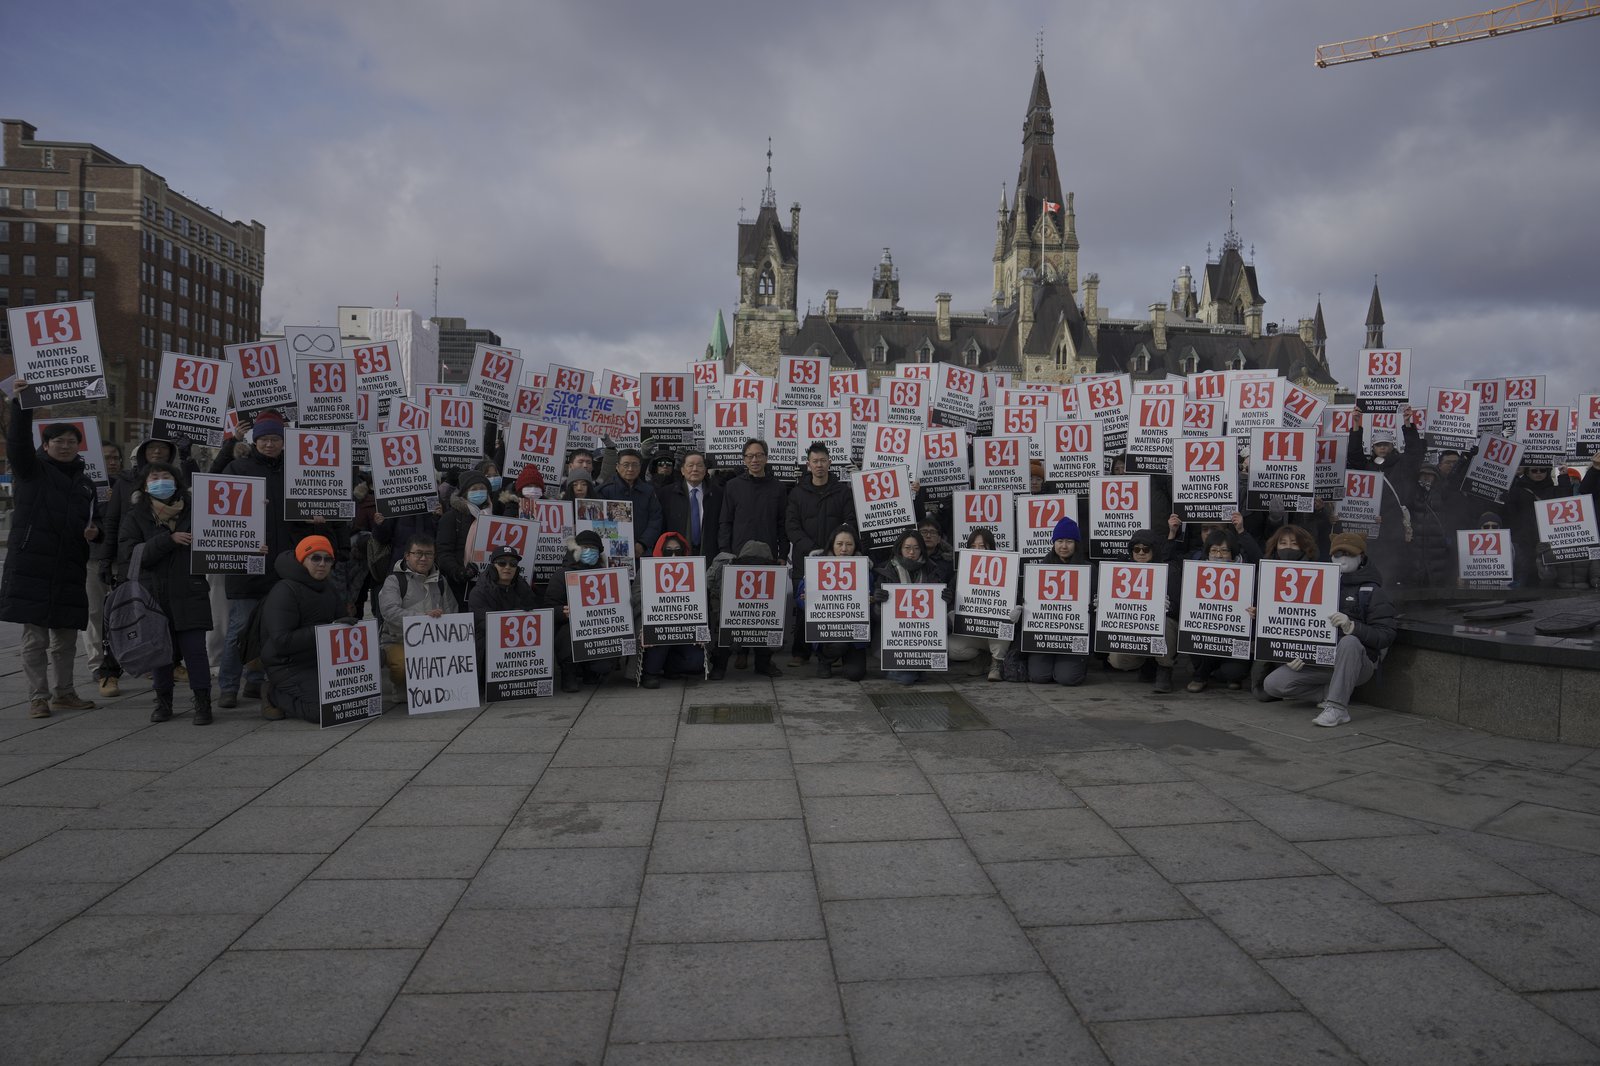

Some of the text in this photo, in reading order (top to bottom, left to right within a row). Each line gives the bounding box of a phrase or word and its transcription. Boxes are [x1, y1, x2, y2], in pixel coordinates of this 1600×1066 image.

[34, 308, 73, 345] 13
[27, 355, 89, 370] WAITING FOR
[37, 346, 77, 357] MONTHS
[243, 345, 277, 376] 30
[357, 347, 388, 373] 35
[24, 364, 96, 380] IRCC RESPONSE
[484, 356, 510, 382] 42
[696, 365, 715, 383] 25
[792, 361, 817, 383] 53
[1371, 352, 1398, 376] 38
[48, 380, 88, 391] TIMELINES
[178, 361, 214, 393] 30
[313, 364, 343, 392] 36
[561, 370, 580, 391] 39
[656, 378, 679, 400] 11
[834, 375, 853, 397] 31
[951, 368, 972, 392] 33
[1199, 375, 1221, 399] 11
[552, 390, 614, 411] STOP THE
[737, 380, 759, 400] 15
[893, 383, 919, 405] 68
[1092, 381, 1120, 409] 33
[1243, 383, 1270, 409] 35
[1508, 380, 1534, 400] 28
[444, 401, 470, 428] 40
[519, 392, 541, 414] 32
[853, 399, 877, 421] 34
[1146, 400, 1171, 426] 70
[1285, 390, 1313, 417] 27
[1441, 392, 1468, 414] 32
[401, 406, 426, 429] 20
[719, 404, 743, 427] 71
[811, 412, 838, 437] 63
[1008, 410, 1033, 433] 55
[1184, 404, 1211, 428] 23
[1530, 410, 1555, 431] 37
[303, 434, 335, 465] 34
[385, 436, 418, 466] 38
[523, 425, 553, 454] 54
[879, 427, 906, 453] 68
[927, 433, 955, 459] 55
[1059, 426, 1089, 452] 90
[1268, 432, 1297, 460] 11
[1487, 438, 1513, 464] 30
[988, 441, 1016, 466] 34
[1189, 442, 1221, 471] 22
[290, 488, 347, 496] IRCC RESPONSE
[867, 471, 896, 500] 39
[1105, 482, 1135, 510] 65
[1350, 475, 1372, 497] 31
[214, 482, 248, 516] 37
[968, 495, 998, 522] 40
[537, 505, 561, 533] 40
[1032, 501, 1060, 528] 72
[1550, 500, 1580, 524] 23
[491, 522, 523, 551] 42
[1472, 534, 1498, 555] 22
[660, 563, 690, 592] 62
[821, 562, 853, 590] 35
[972, 556, 1003, 586] 40
[1115, 567, 1149, 598] 34
[1200, 567, 1235, 599] 36
[584, 573, 616, 605] 31
[739, 571, 770, 599] 81
[1043, 571, 1073, 600] 51
[1280, 568, 1319, 602] 37
[651, 604, 683, 612] WAITING
[659, 596, 690, 604] MONTHS
[898, 590, 930, 618] 43
[1041, 604, 1072, 612] MONTHS
[1198, 602, 1233, 612] MONTHS
[647, 612, 703, 622] IRCC RESPONSE
[1032, 612, 1064, 620] WAITING
[1045, 622, 1084, 630] RESPONSE
[1184, 620, 1245, 633] IRCC RESPONSE
[1190, 611, 1241, 623] WAITING FOR
[405, 623, 475, 647] CANADA
[504, 616, 536, 647] 36
[335, 628, 364, 663] 18
[1204, 643, 1233, 653] RESULTS
[336, 665, 365, 676] MONTHS
[406, 656, 473, 680] WHAT ARE
[325, 683, 377, 699] IRCC RESPONSE
[329, 673, 373, 688] WAITING FOR
[342, 699, 368, 711] TIMELINE
